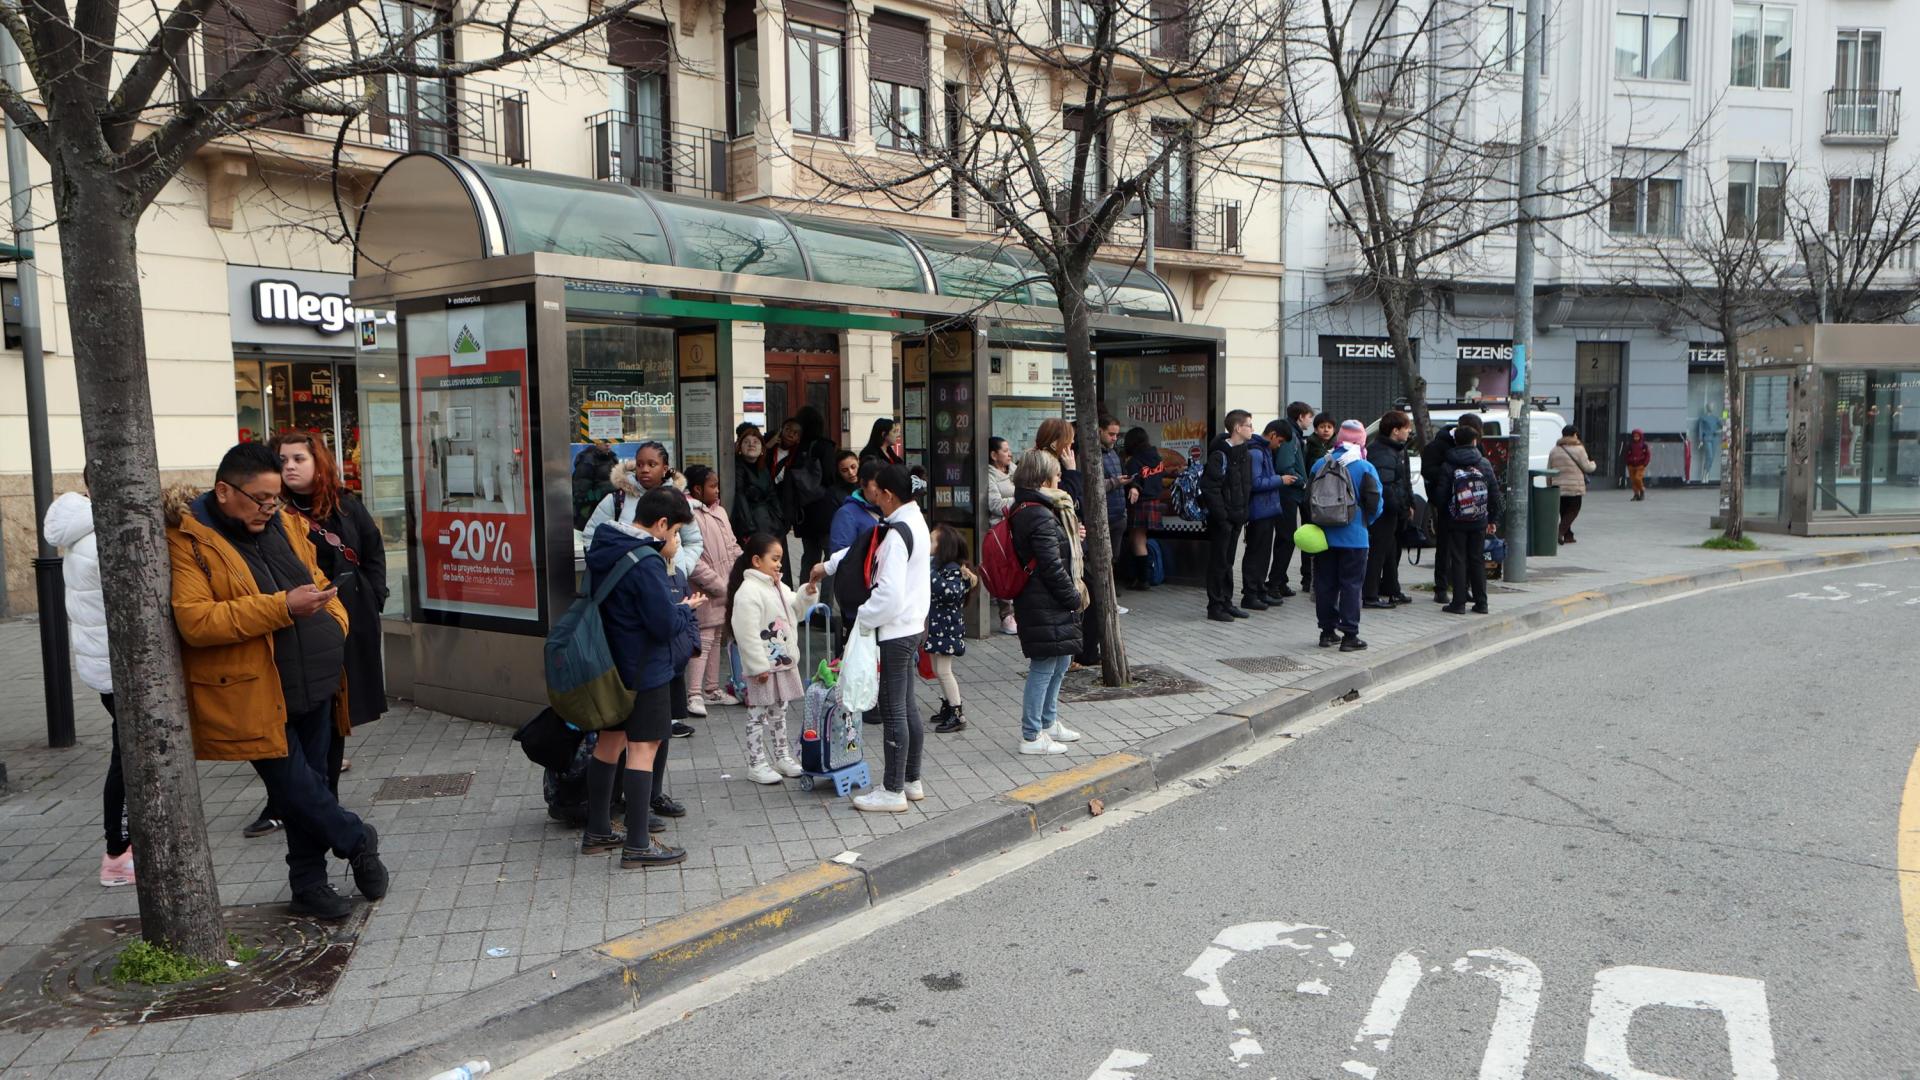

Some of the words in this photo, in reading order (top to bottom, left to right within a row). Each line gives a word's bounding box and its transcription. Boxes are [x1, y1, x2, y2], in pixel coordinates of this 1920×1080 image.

[453, 329, 464, 353] LEROY
[463, 323, 481, 351] MERLIN
[1591, 358, 1599, 369] 2
[440, 378, 466, 387] EXCLUSIVO
[466, 377, 484, 385] SOCIOS
[940, 388, 946, 401] 8
[956, 387, 968, 401] 10
[1141, 391, 1172, 404] TUTTI
[1127, 403, 1184, 423] PEPPERONI
[938, 414, 949, 428] 12
[956, 414, 969, 428] 20
[937, 441, 950, 454] 23
[956, 442, 970, 454] N2
[946, 468, 960, 481] N6
[936, 491, 951, 503] N13
[954, 490, 970, 503] N16
[438, 519, 512, 563] -20%
[443, 563, 450, 571] en
[457, 565, 482, 575] proyecto
[483, 566, 490, 574] de
[491, 566, 515, 576] reforma
[443, 573, 450, 582] de
[465, 575, 472, 583] de
